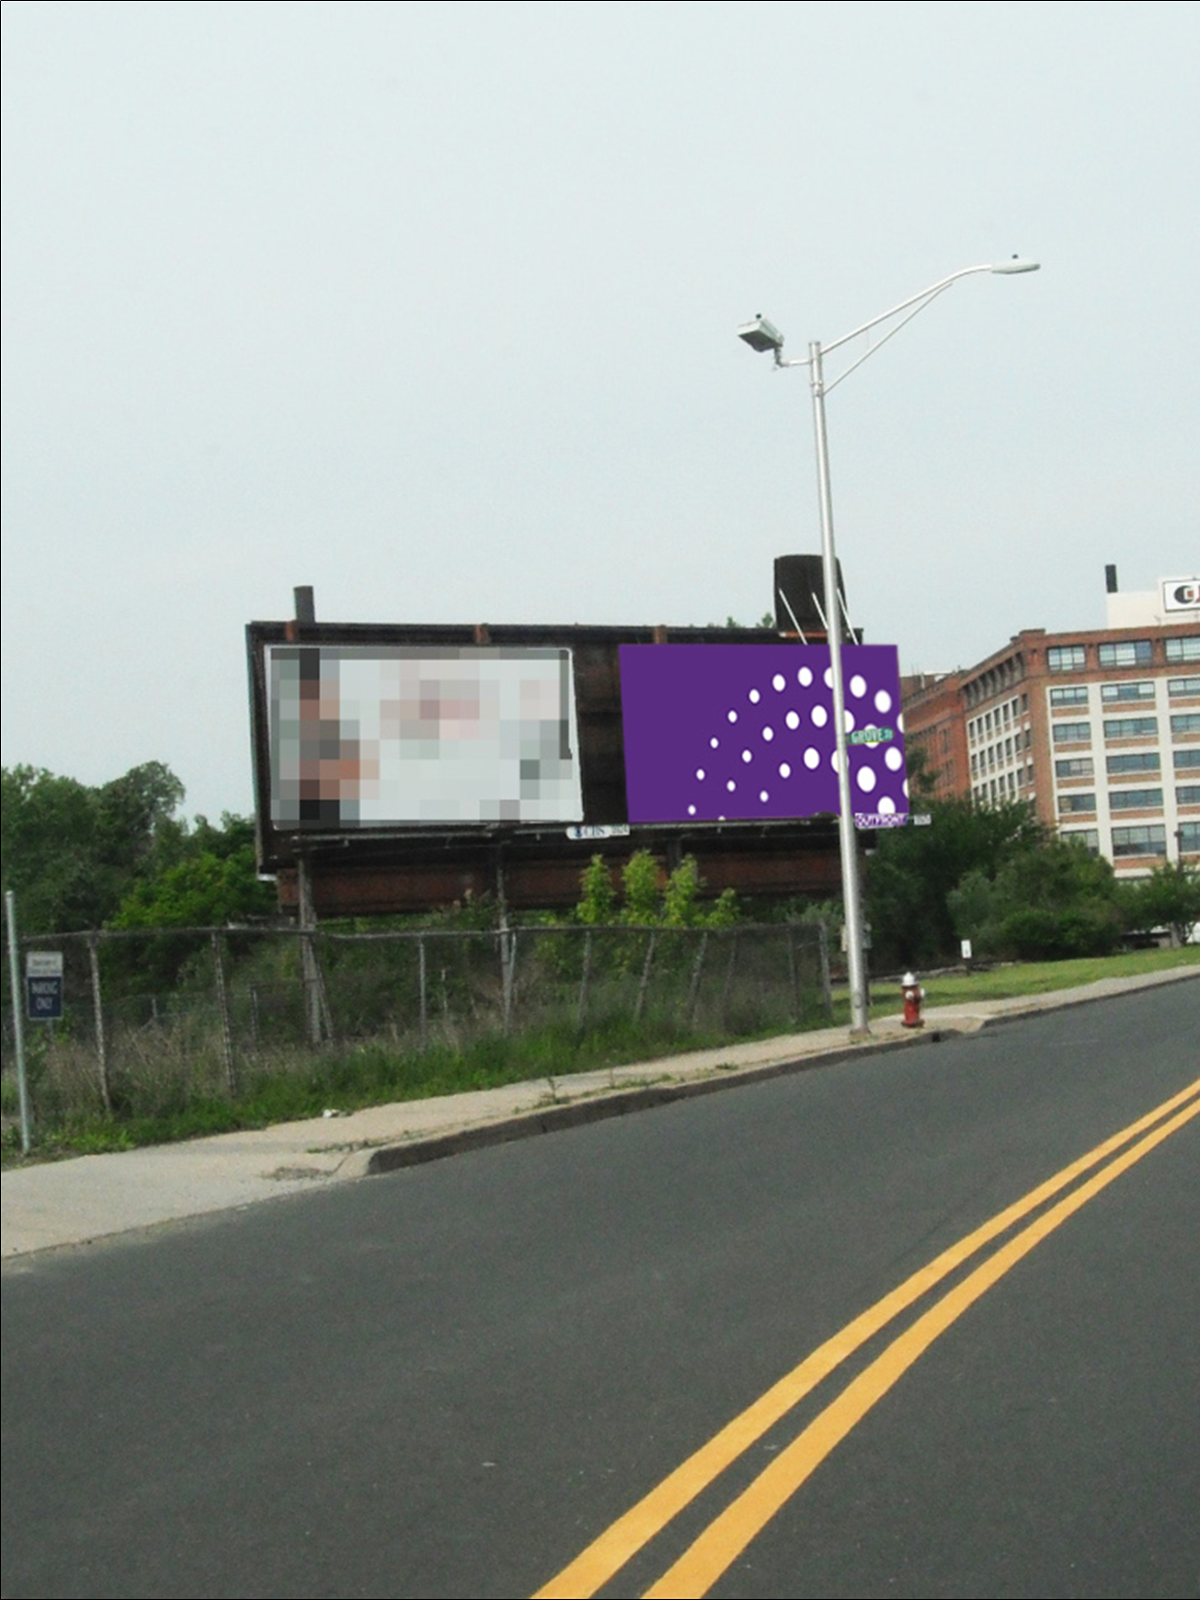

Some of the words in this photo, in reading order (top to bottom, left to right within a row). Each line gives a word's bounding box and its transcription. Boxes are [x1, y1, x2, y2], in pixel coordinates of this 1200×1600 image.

[851, 728, 882, 744] GROVE
[855, 813, 906, 826] OUTFRONT
[36, 997, 53, 1010] ONLY
